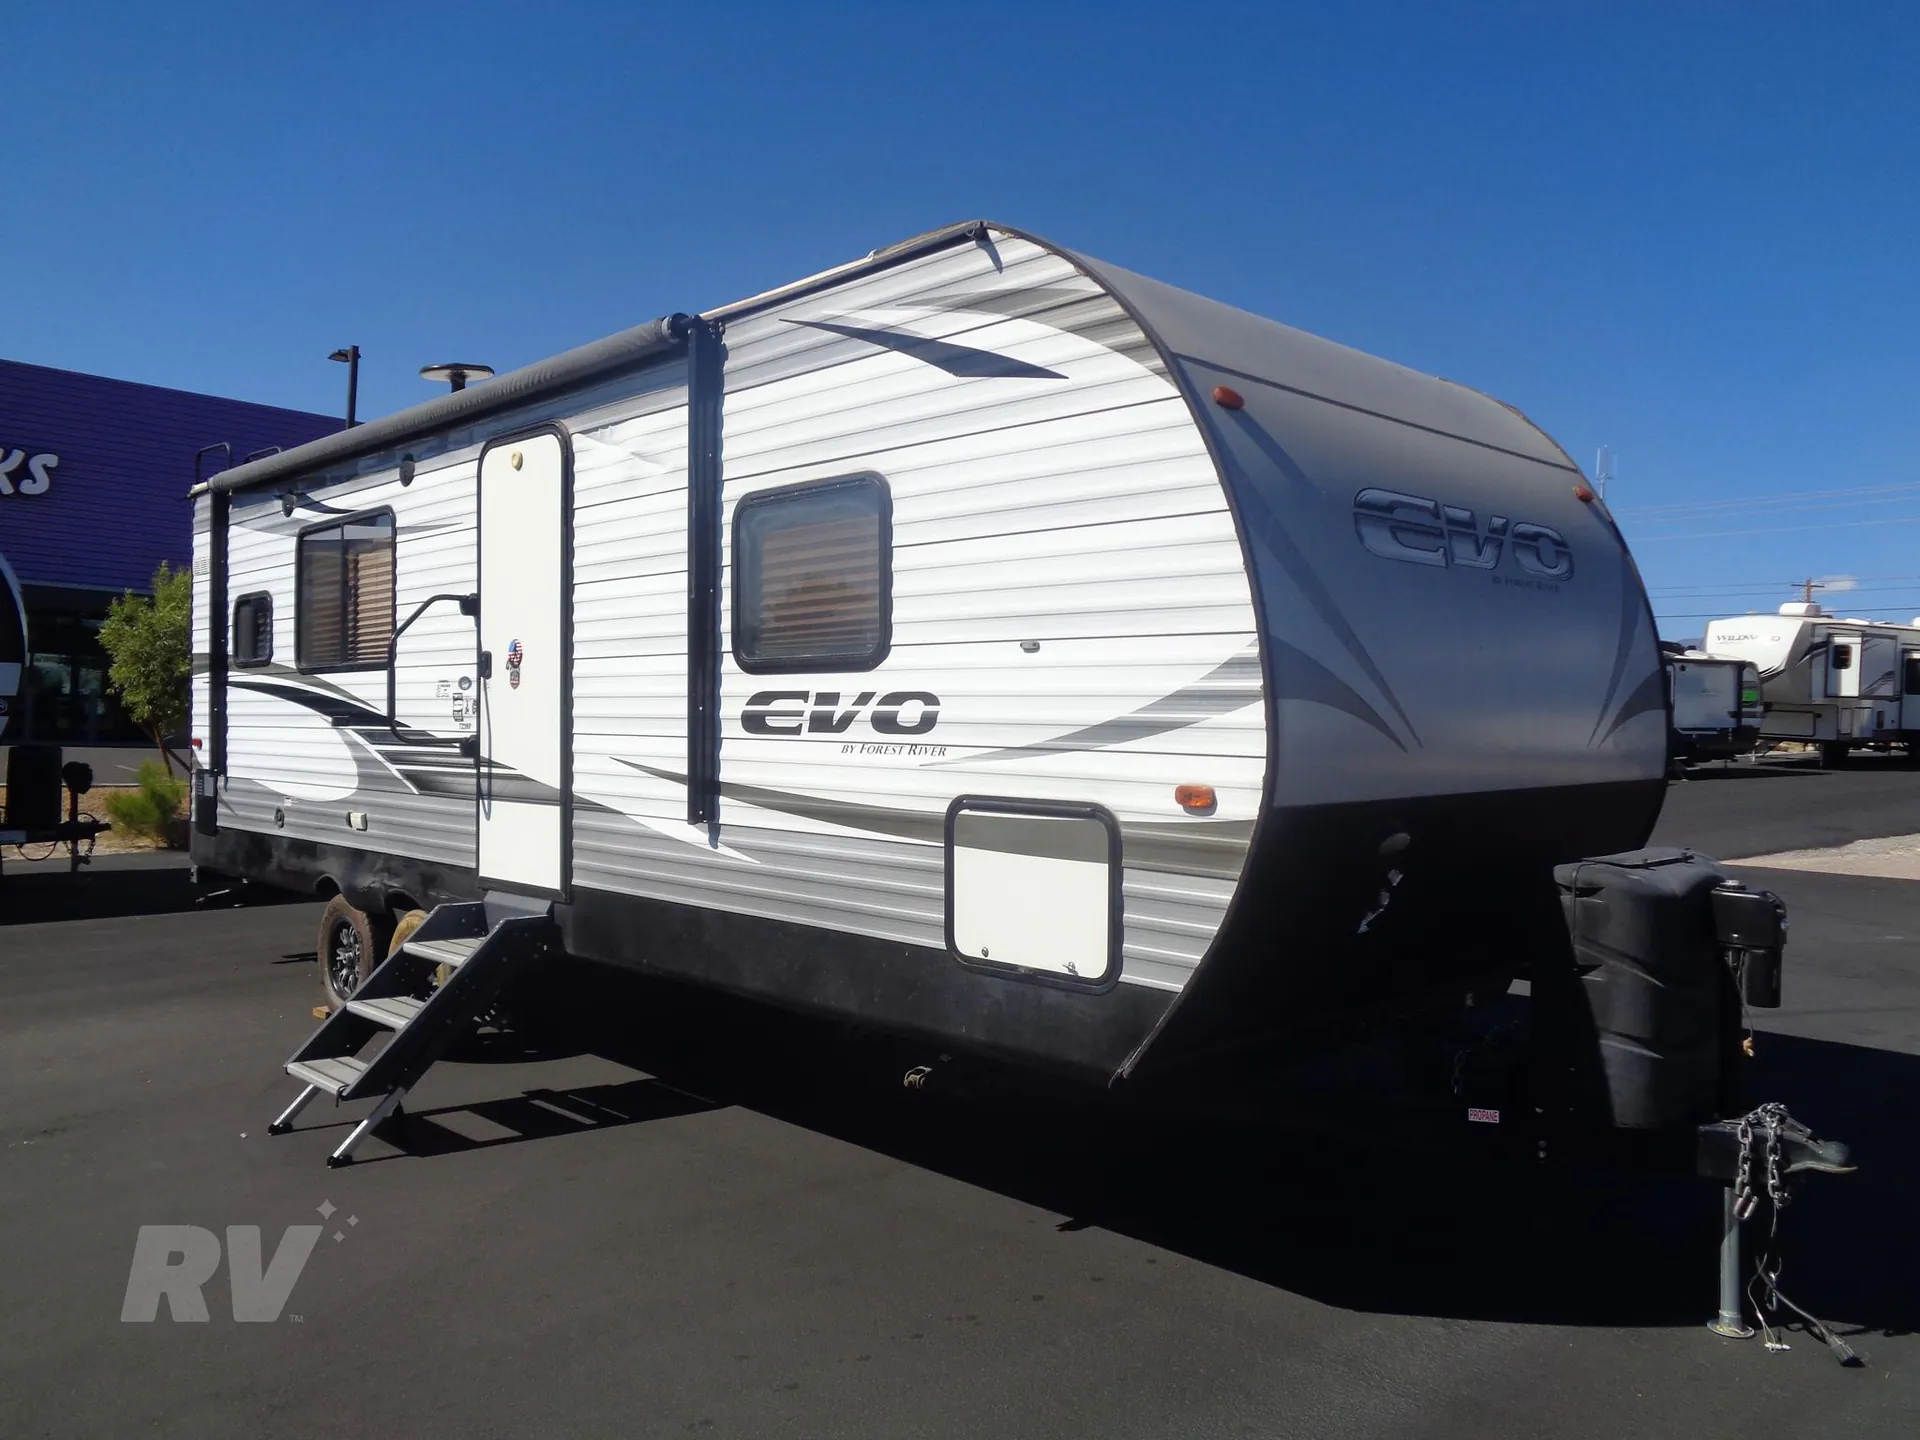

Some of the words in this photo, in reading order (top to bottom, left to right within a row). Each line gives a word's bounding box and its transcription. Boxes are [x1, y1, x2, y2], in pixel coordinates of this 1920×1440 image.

[1352, 487, 1574, 582] EVO
[741, 690, 941, 736] EVO
[841, 744, 856, 754] BY
[1470, 1109, 1498, 1121] PROPANE
